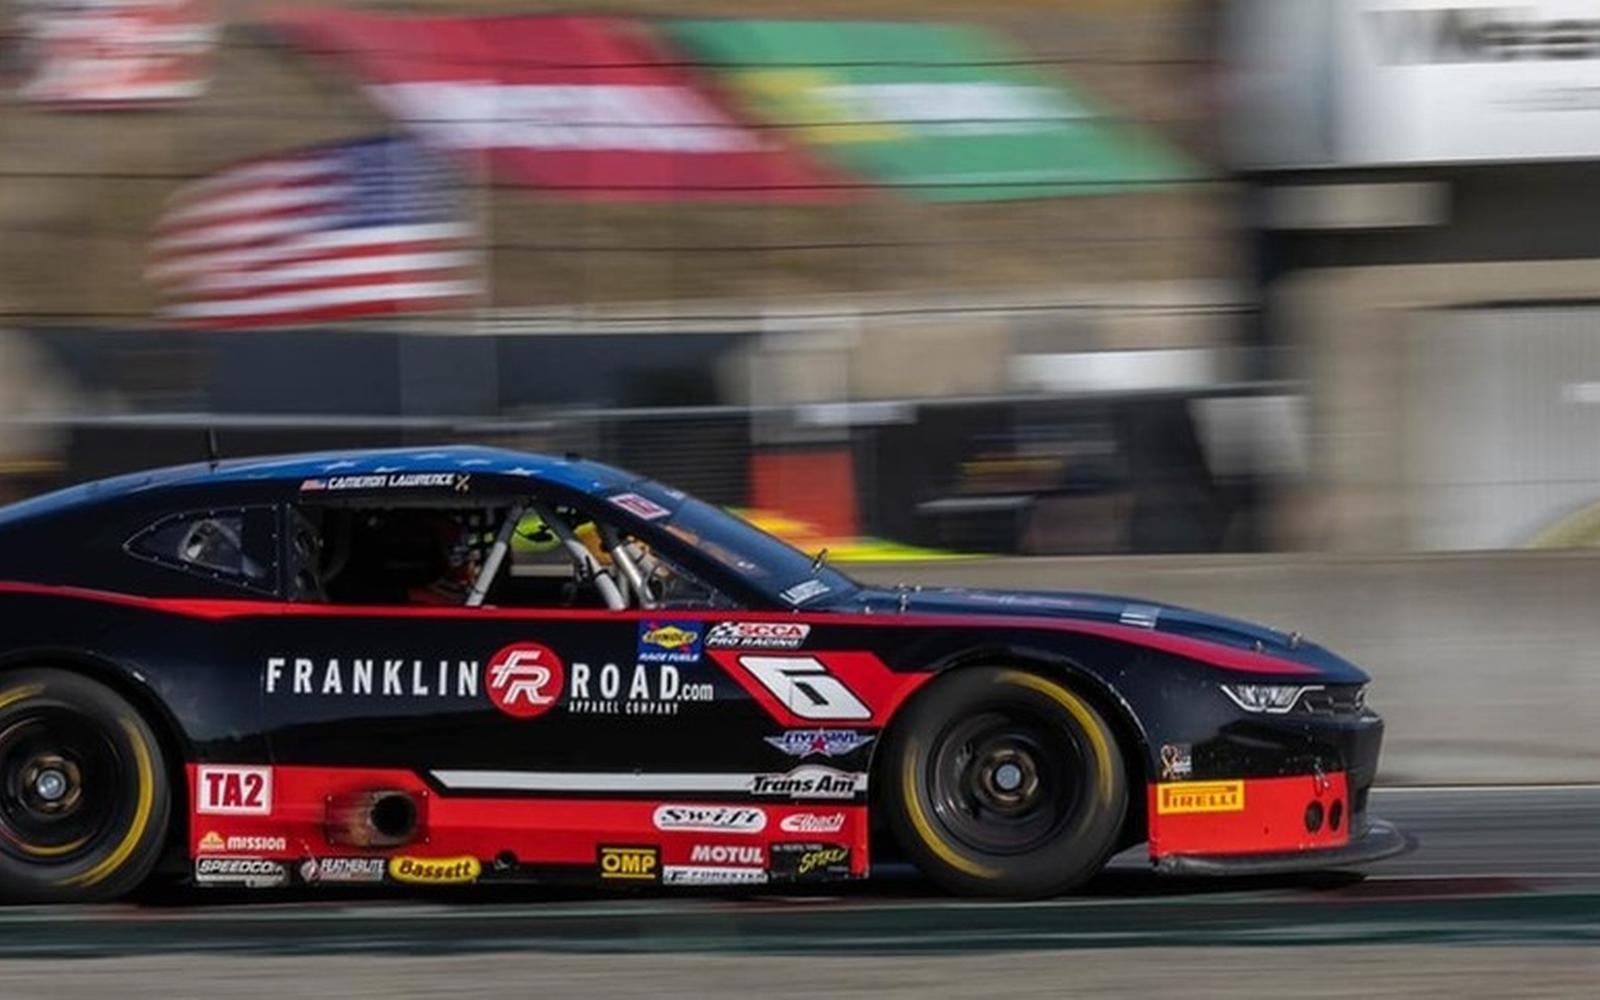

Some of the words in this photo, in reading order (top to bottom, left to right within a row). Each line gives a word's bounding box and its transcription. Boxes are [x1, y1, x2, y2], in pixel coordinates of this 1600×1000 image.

[328, 475, 386, 489] CAMERON
[388, 474, 455, 487] LAWRENCE
[738, 623, 802, 637] SCCA
[708, 637, 739, 646] PRO
[741, 638, 799, 647] RACING
[639, 653, 667, 662] RACE
[668, 653, 699, 662] FUELS
[266, 658, 478, 697] FRANKLIN
[739, 656, 872, 719] 6
[569, 701, 619, 713] APPAREL
[625, 701, 678, 715] COMPANY
[205, 773, 264, 807] TA2
[1163, 786, 1237, 808] PIRELLI
[661, 808, 758, 825] Swift
[691, 845, 763, 863] MOTUL
[400, 860, 471, 878] Bassett
[602, 854, 656, 873] OMP
